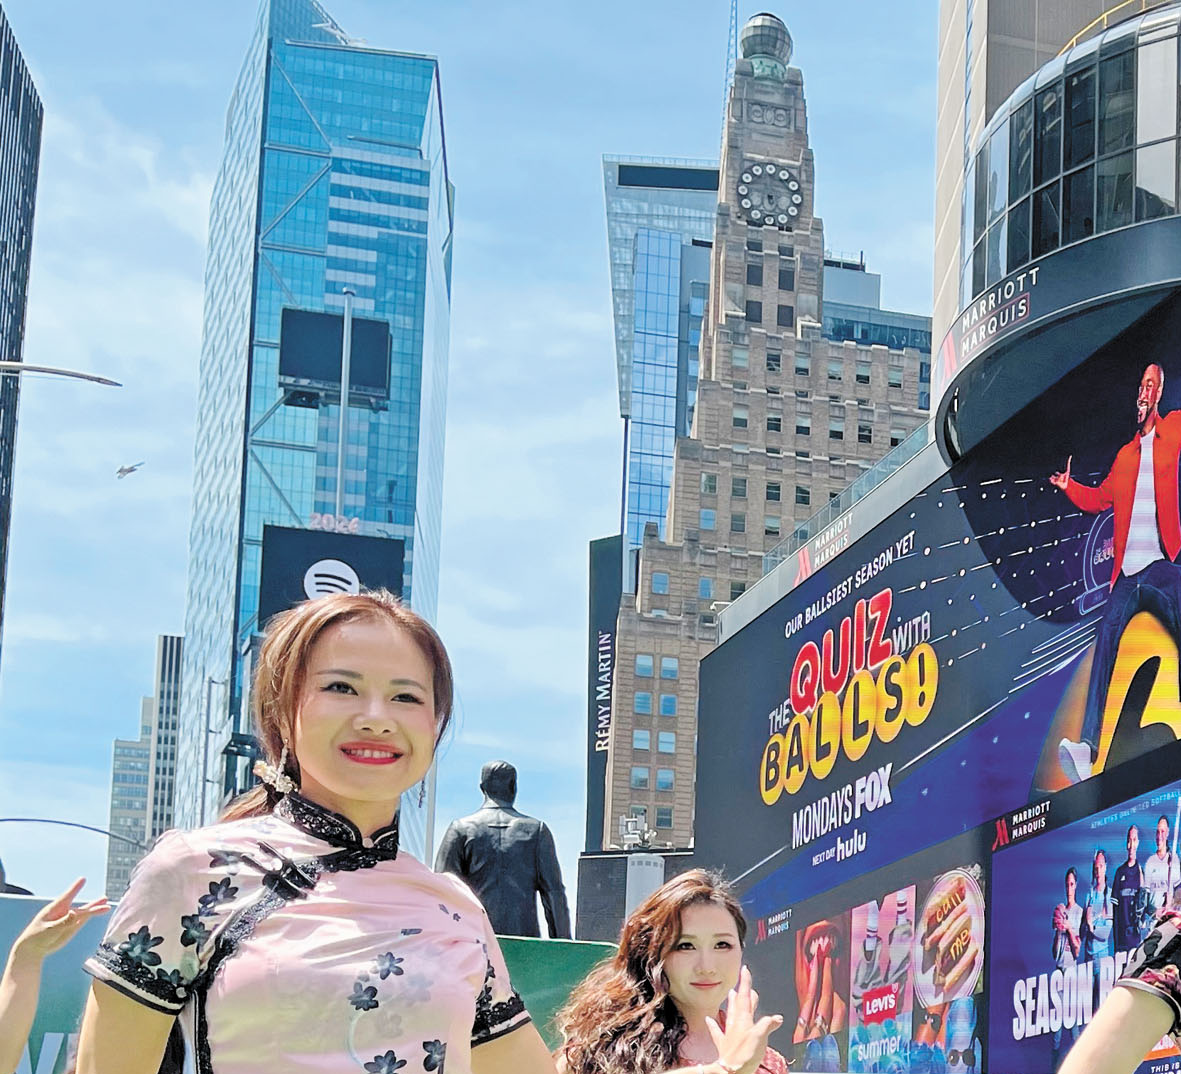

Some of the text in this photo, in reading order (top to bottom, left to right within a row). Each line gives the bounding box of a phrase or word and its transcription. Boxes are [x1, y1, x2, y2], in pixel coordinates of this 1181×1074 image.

[961, 299, 1027, 357] MARQUIS
[962, 267, 1040, 333] MARRIOTT
[814, 534, 849, 569] MARQUIS
[815, 512, 853, 550] MARRIOTT
[785, 530, 915, 638] OUR BALLSIEST SEASON YET
[768, 587, 931, 736] THE QUIZ WITH
[596, 632, 611, 752] RÉMY MARTIN
[764, 651, 927, 793] BALLS!
[792, 762, 893, 850] MONDAYS FOX
[1012, 801, 1050, 826] MARRIOTT
[1012, 817, 1046, 840] MARQUIS
[812, 828, 867, 866] NEXT DAY hulu
[768, 908, 792, 926] MARRIOTT
[1012, 960, 1094, 1042] SEASON
[857, 1036, 902, 1061] summer
